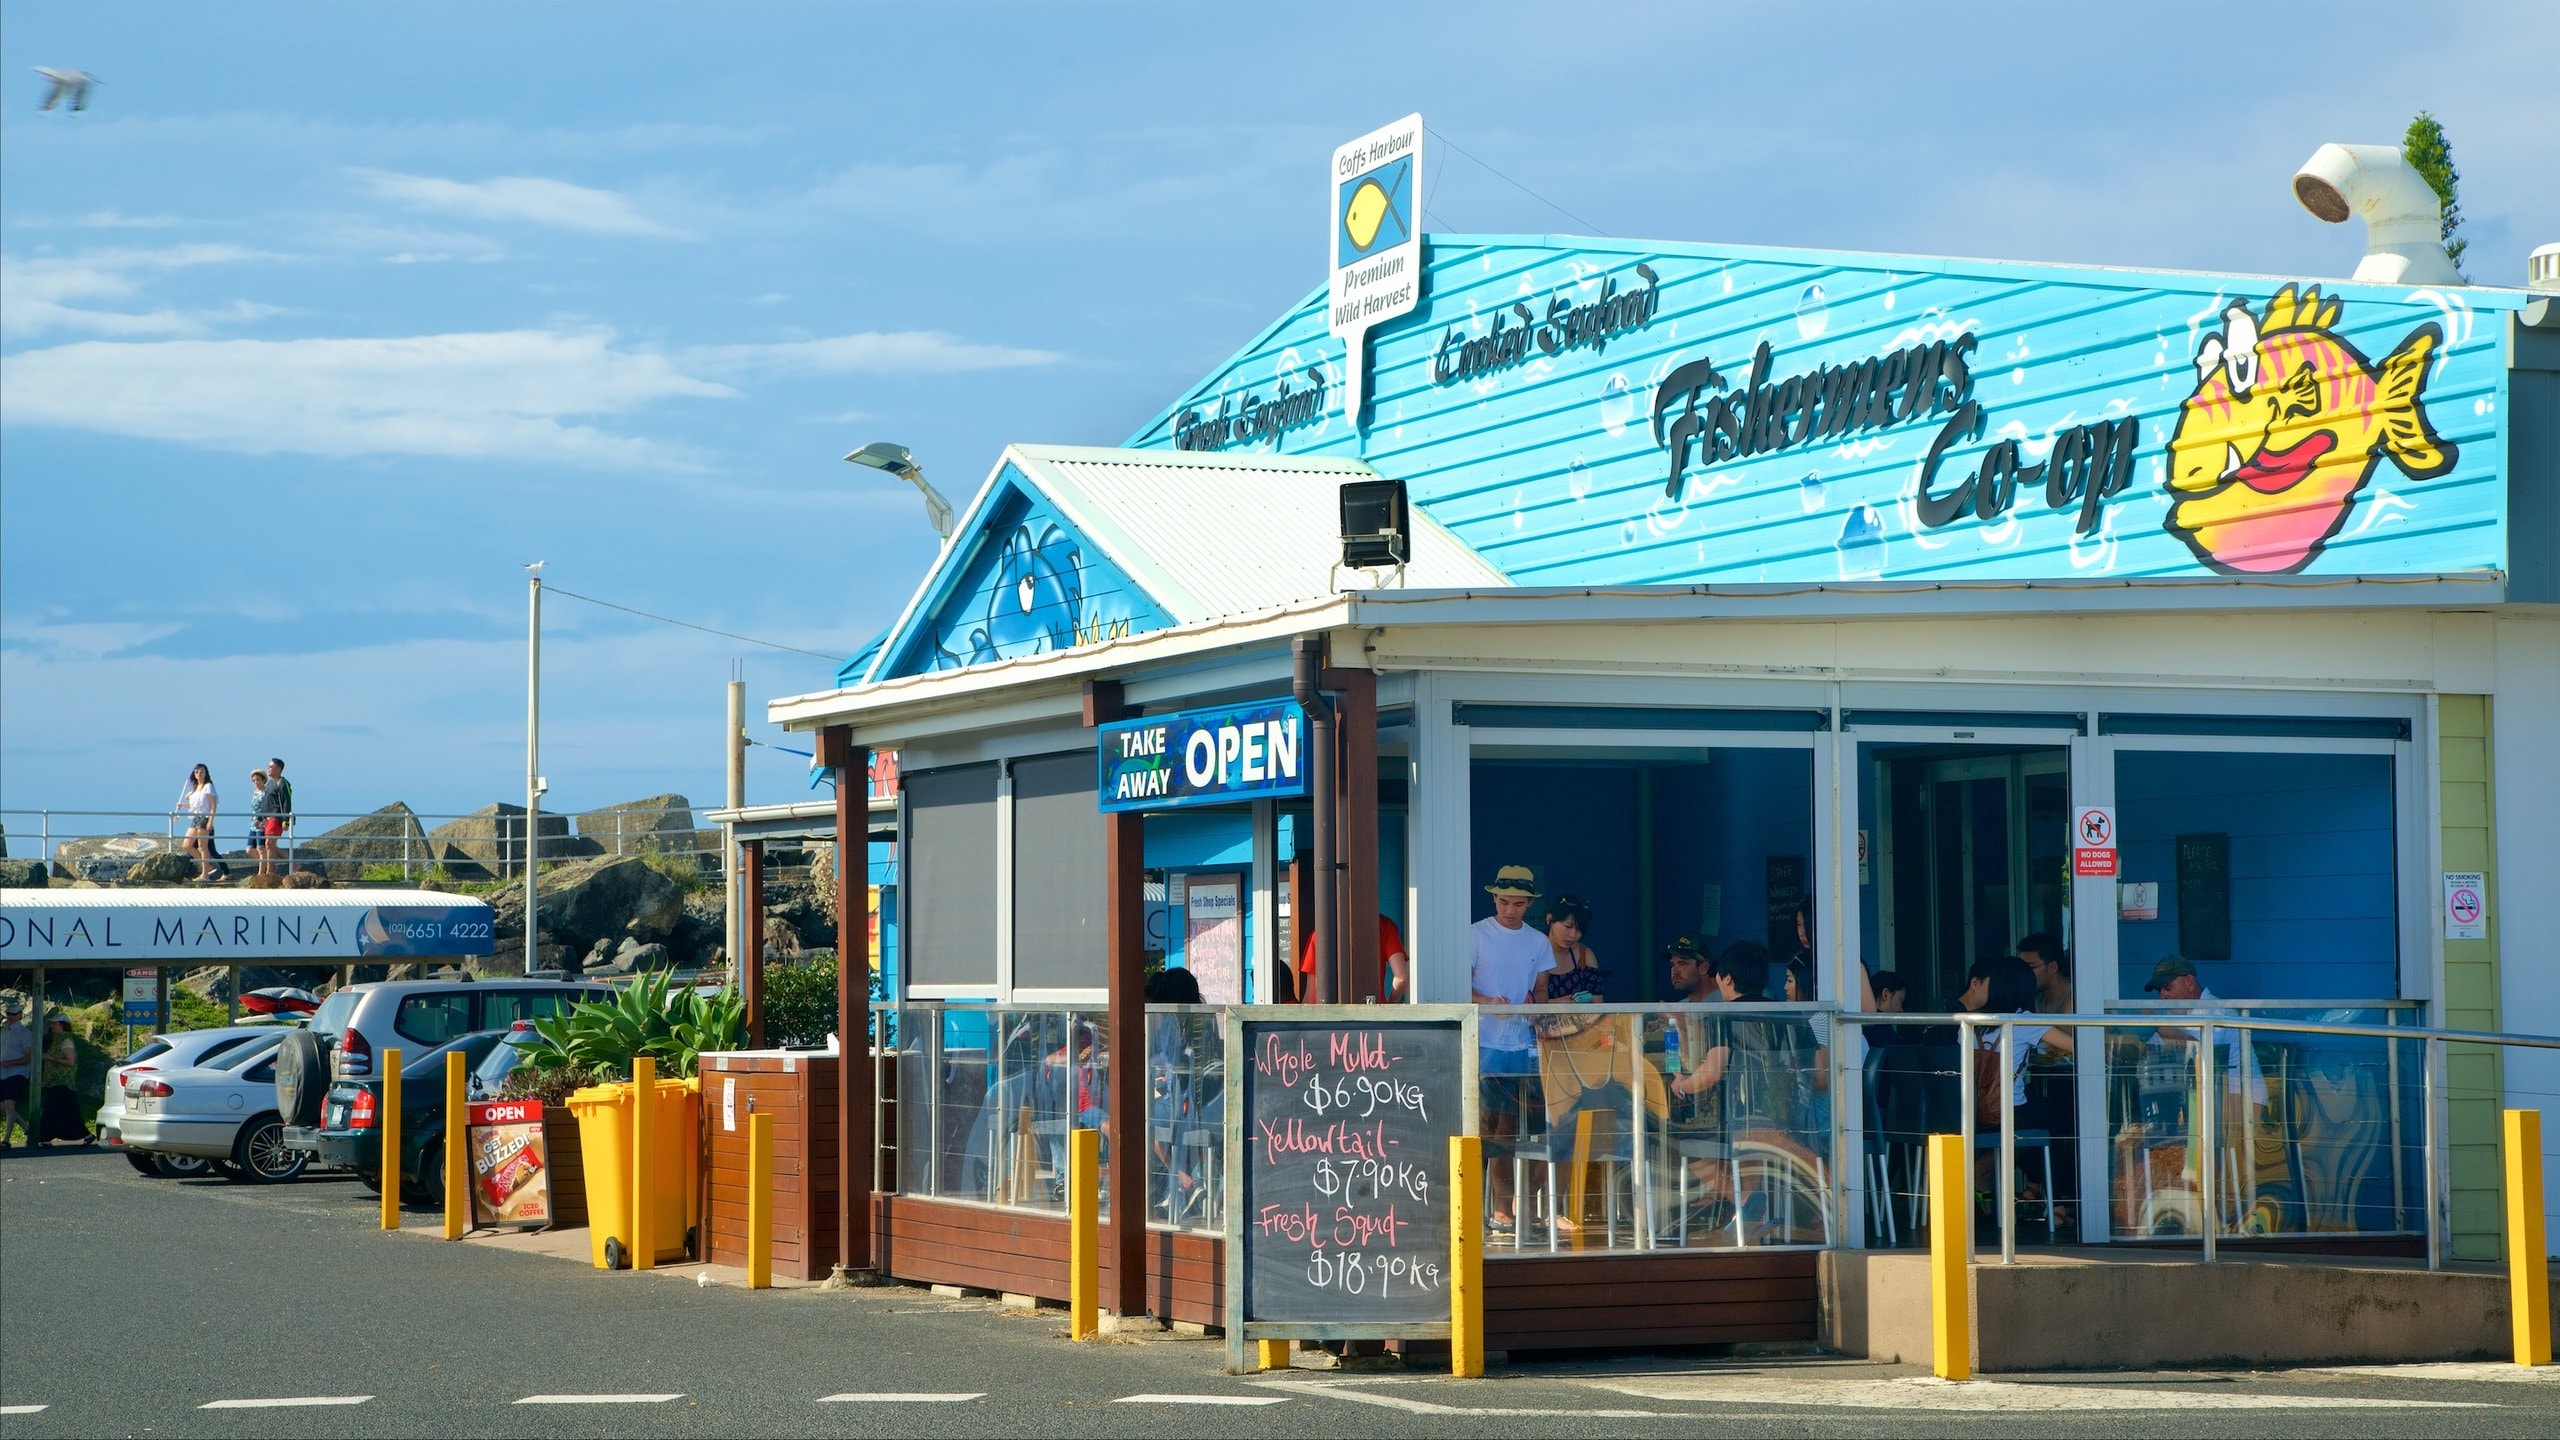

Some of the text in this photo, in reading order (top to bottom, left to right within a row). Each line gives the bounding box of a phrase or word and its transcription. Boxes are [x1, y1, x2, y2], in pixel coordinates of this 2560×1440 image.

[1339, 129, 1414, 176] Coffs Harbour
[1343, 256, 1404, 297] Premium
[1335, 282, 1411, 327] Wild Harvest
[1435, 263, 1658, 384] Cooked Seafood
[1175, 367, 1325, 451] Fresh Seafood
[1654, 332, 1979, 499] Fishermens
[1917, 399, 2140, 535] Co-op
[1120, 727, 1166, 758] TAKE
[1185, 718, 1297, 788] OPEN
[1116, 768, 1171, 799] AWAY
[2081, 851, 2110, 859] NO DOGS
[1203, 896, 1214, 909] Shop
[1215, 895, 1236, 909] Specials
[153, 915, 338, 946] MARINA
[450, 923, 489, 938] 4222
[485, 1106, 525, 1121] OPEN
[475, 1133, 530, 1175] BUZZED!
[483, 1136, 502, 1154] GET
[519, 1208, 544, 1217] COFFEE
